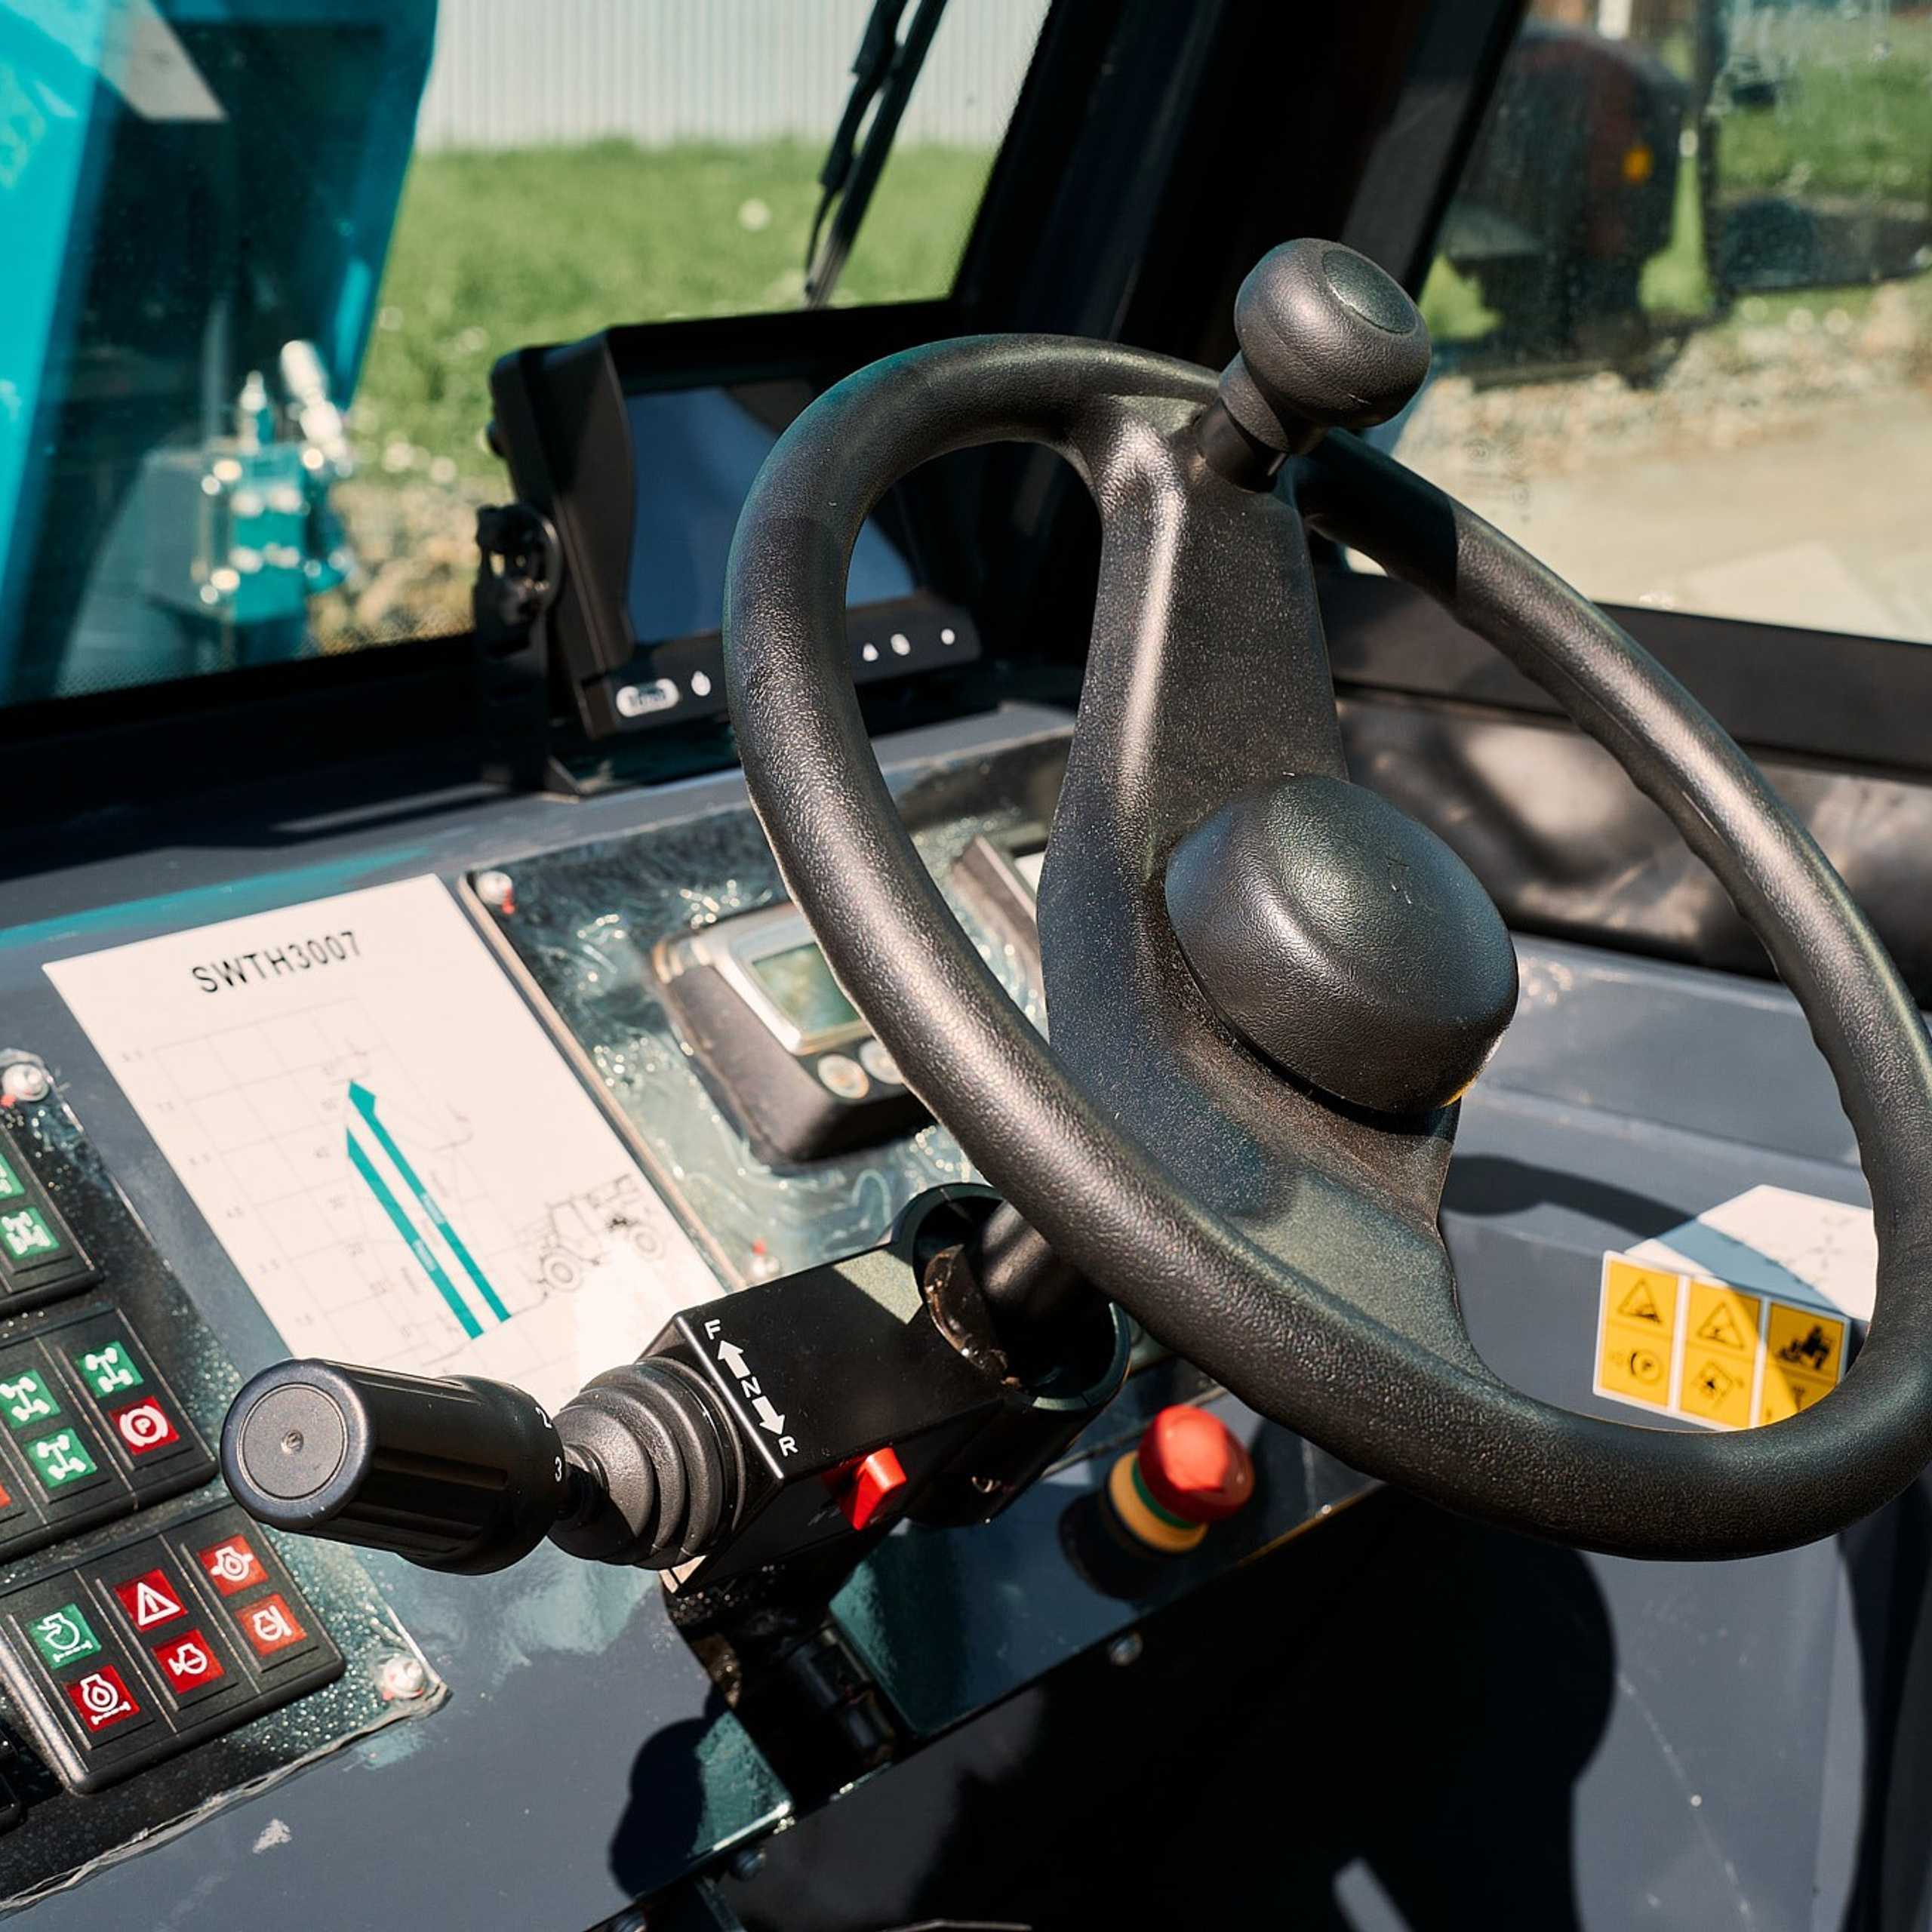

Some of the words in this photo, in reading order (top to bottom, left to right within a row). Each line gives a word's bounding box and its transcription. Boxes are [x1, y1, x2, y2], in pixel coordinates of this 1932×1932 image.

[192, 931, 361, 993] SWTH3007
[704, 1318, 721, 1340] F
[740, 1376, 762, 1398] N
[134, 1417, 152, 1435] P
[534, 1406, 552, 1429] 2
[778, 1435, 798, 1457] R
[555, 1456, 562, 1482] 3
